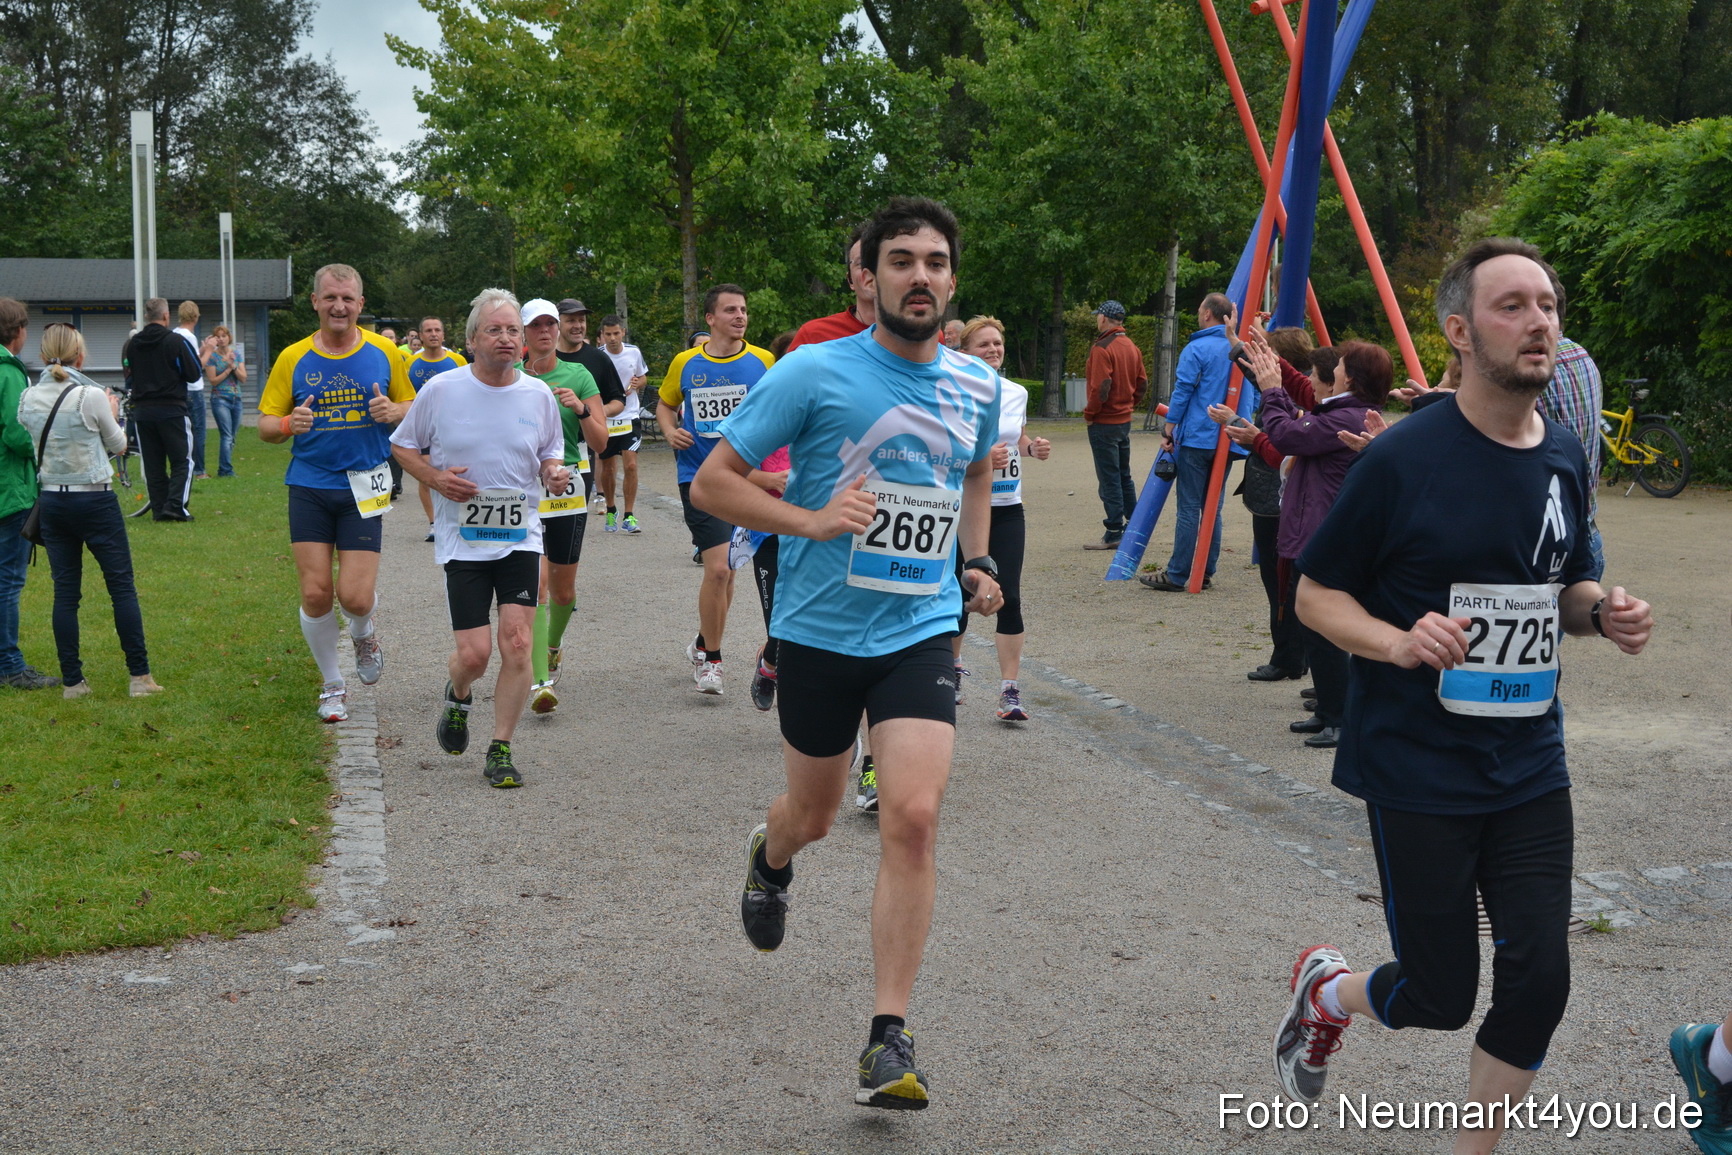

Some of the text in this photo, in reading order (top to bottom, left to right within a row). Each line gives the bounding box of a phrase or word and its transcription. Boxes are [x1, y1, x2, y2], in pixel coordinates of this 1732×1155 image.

[877, 446, 928, 463] anders
[932, 452, 952, 467] als
[371, 473, 387, 493] 42
[991, 483, 1015, 491] rianne
[550, 501, 568, 510] Anke
[864, 490, 950, 511] ARTL Neumarkt
[465, 503, 522, 526] 2715
[476, 530, 510, 540] Herbert
[865, 508, 954, 554] 2687
[889, 561, 926, 580] Peter
[1453, 596, 1550, 611] PARTL Neumarkt
[1464, 617, 1554, 665] 2725
[1490, 679, 1530, 702] Ryan
